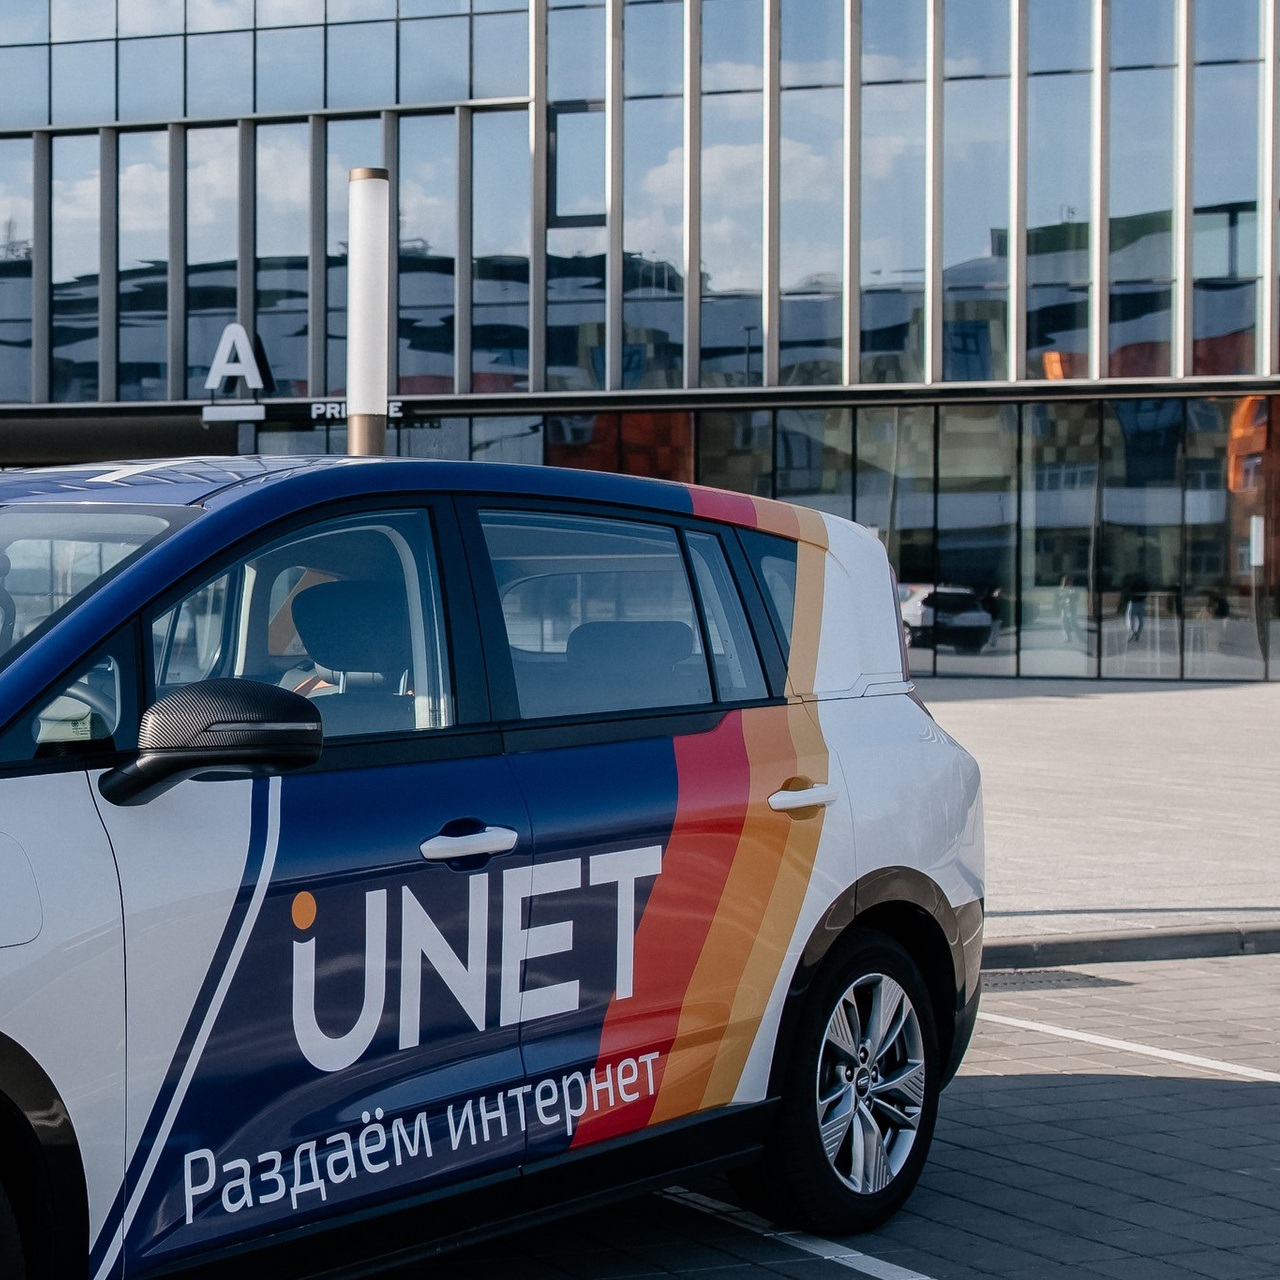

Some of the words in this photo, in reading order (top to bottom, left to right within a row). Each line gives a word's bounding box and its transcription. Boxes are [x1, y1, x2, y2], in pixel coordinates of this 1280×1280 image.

[204, 322, 264, 390] A
[183, 1106, 433, 1225] Раздаём
[447, 1051, 661, 1151] интернет
